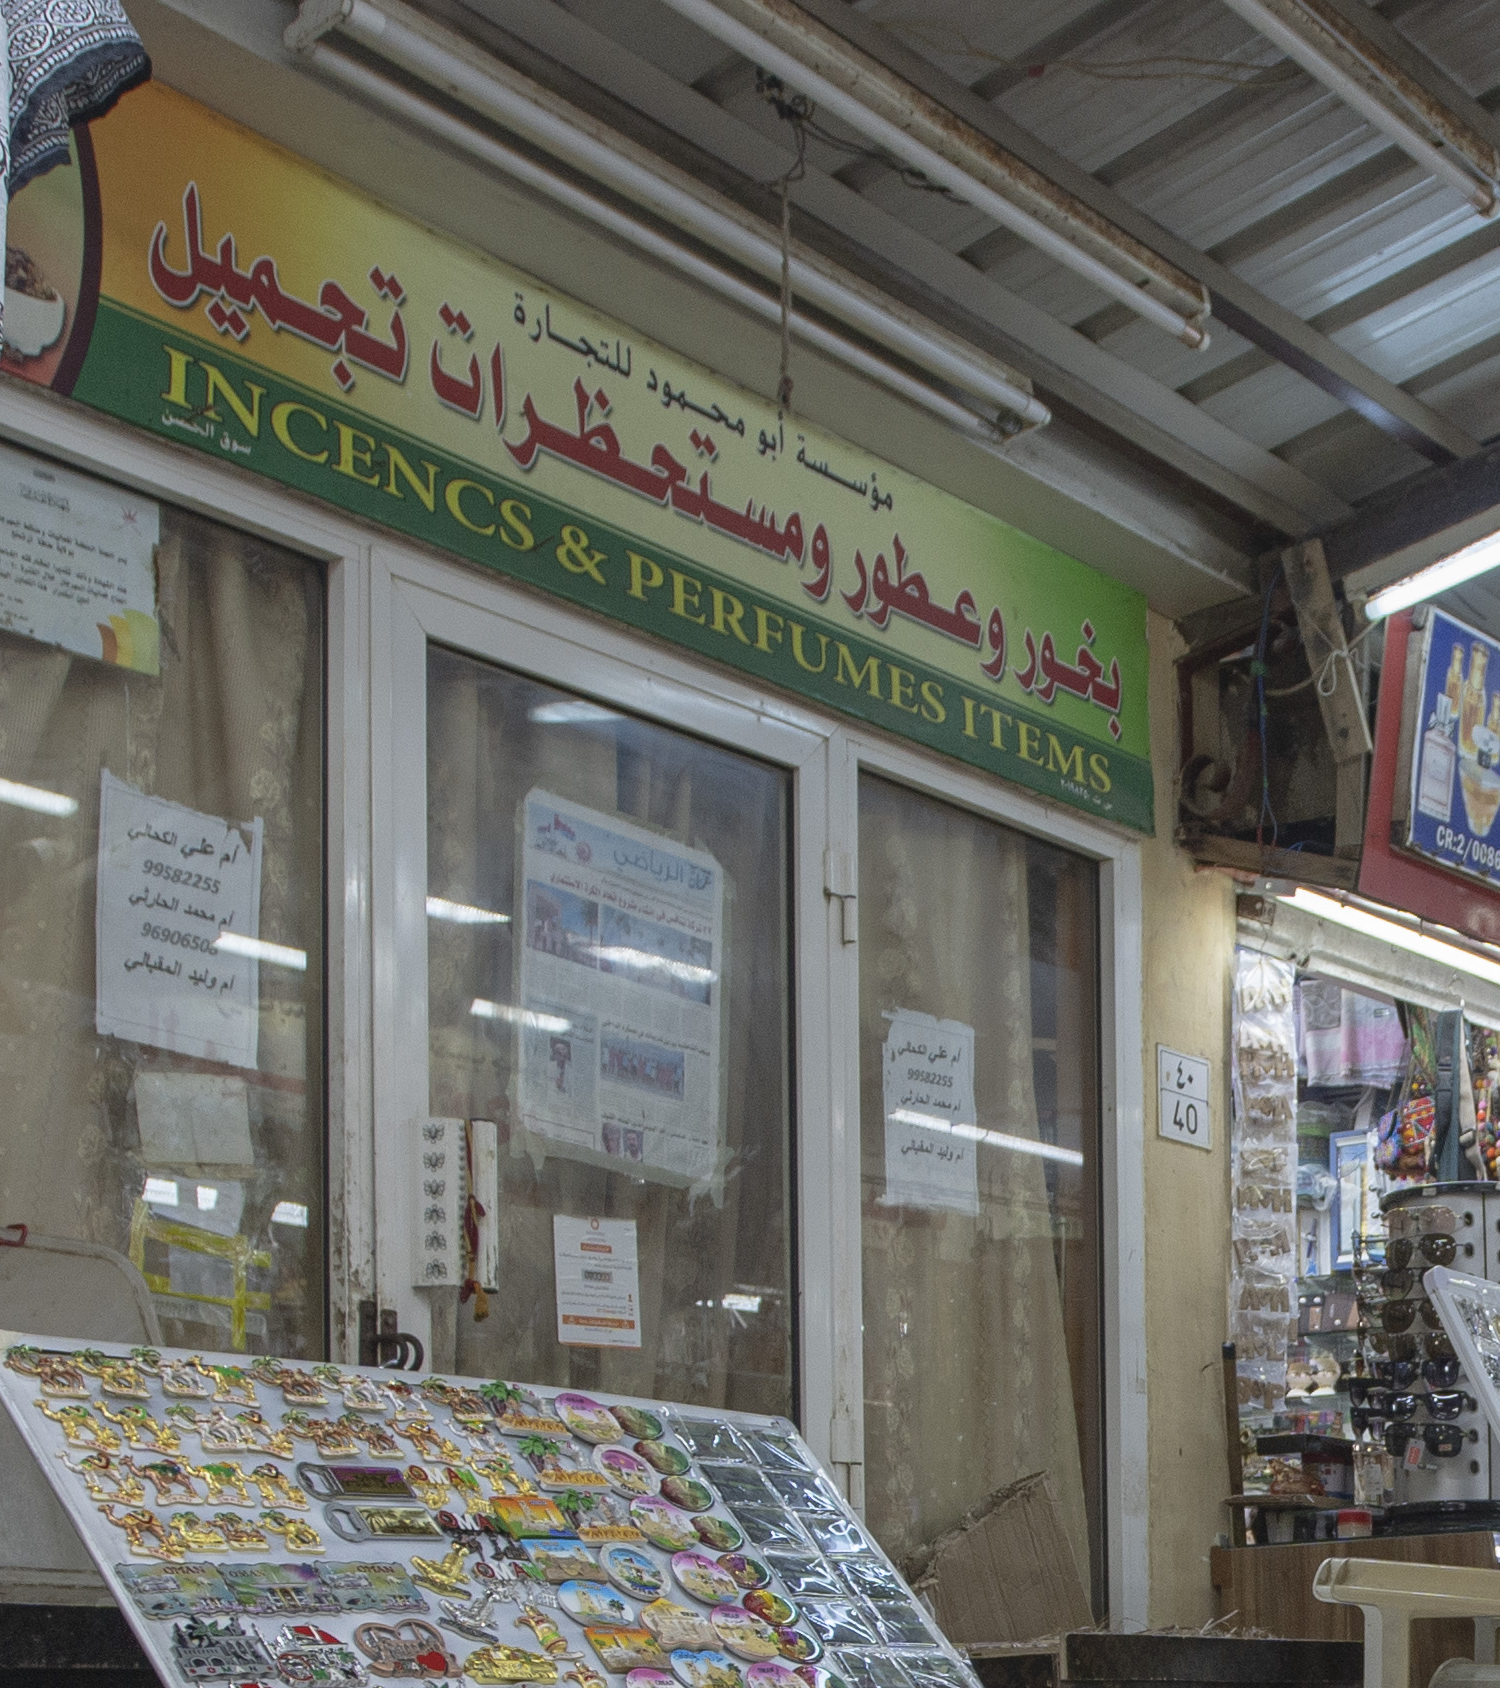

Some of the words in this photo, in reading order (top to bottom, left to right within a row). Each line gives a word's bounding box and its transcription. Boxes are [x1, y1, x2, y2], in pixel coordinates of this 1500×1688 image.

[148, 181, 408, 391] تجميل
[513, 293, 631, 377] للتجارة
[647, 368, 745, 436] محمود
[760, 411, 784, 460] أبو
[797, 436, 893, 511] مؤسسة
[161, 345, 534, 552] INCENCS
[556, 524, 608, 586] &
[625, 550, 946, 723] PERFUMES
[962, 695, 1112, 793] ITEMS
[840, 532, 1005, 679] وعطور
[1013, 619, 1122, 740] بخور
[181, 837, 214, 859] علي
[142, 859, 221, 894] 99582255
[184, 904, 215, 922] محمد
[907, 1069, 953, 1088] 99582255
[1176, 1061, 1193, 1090] ٤٠
[1173, 1101, 1198, 1135] 40
[405, 1465, 479, 1487] OMAN
[163, 1566, 206, 1576] OMAN
[357, 1565, 395, 1575] OMAN
[472, 1561, 546, 1581] OMAN
